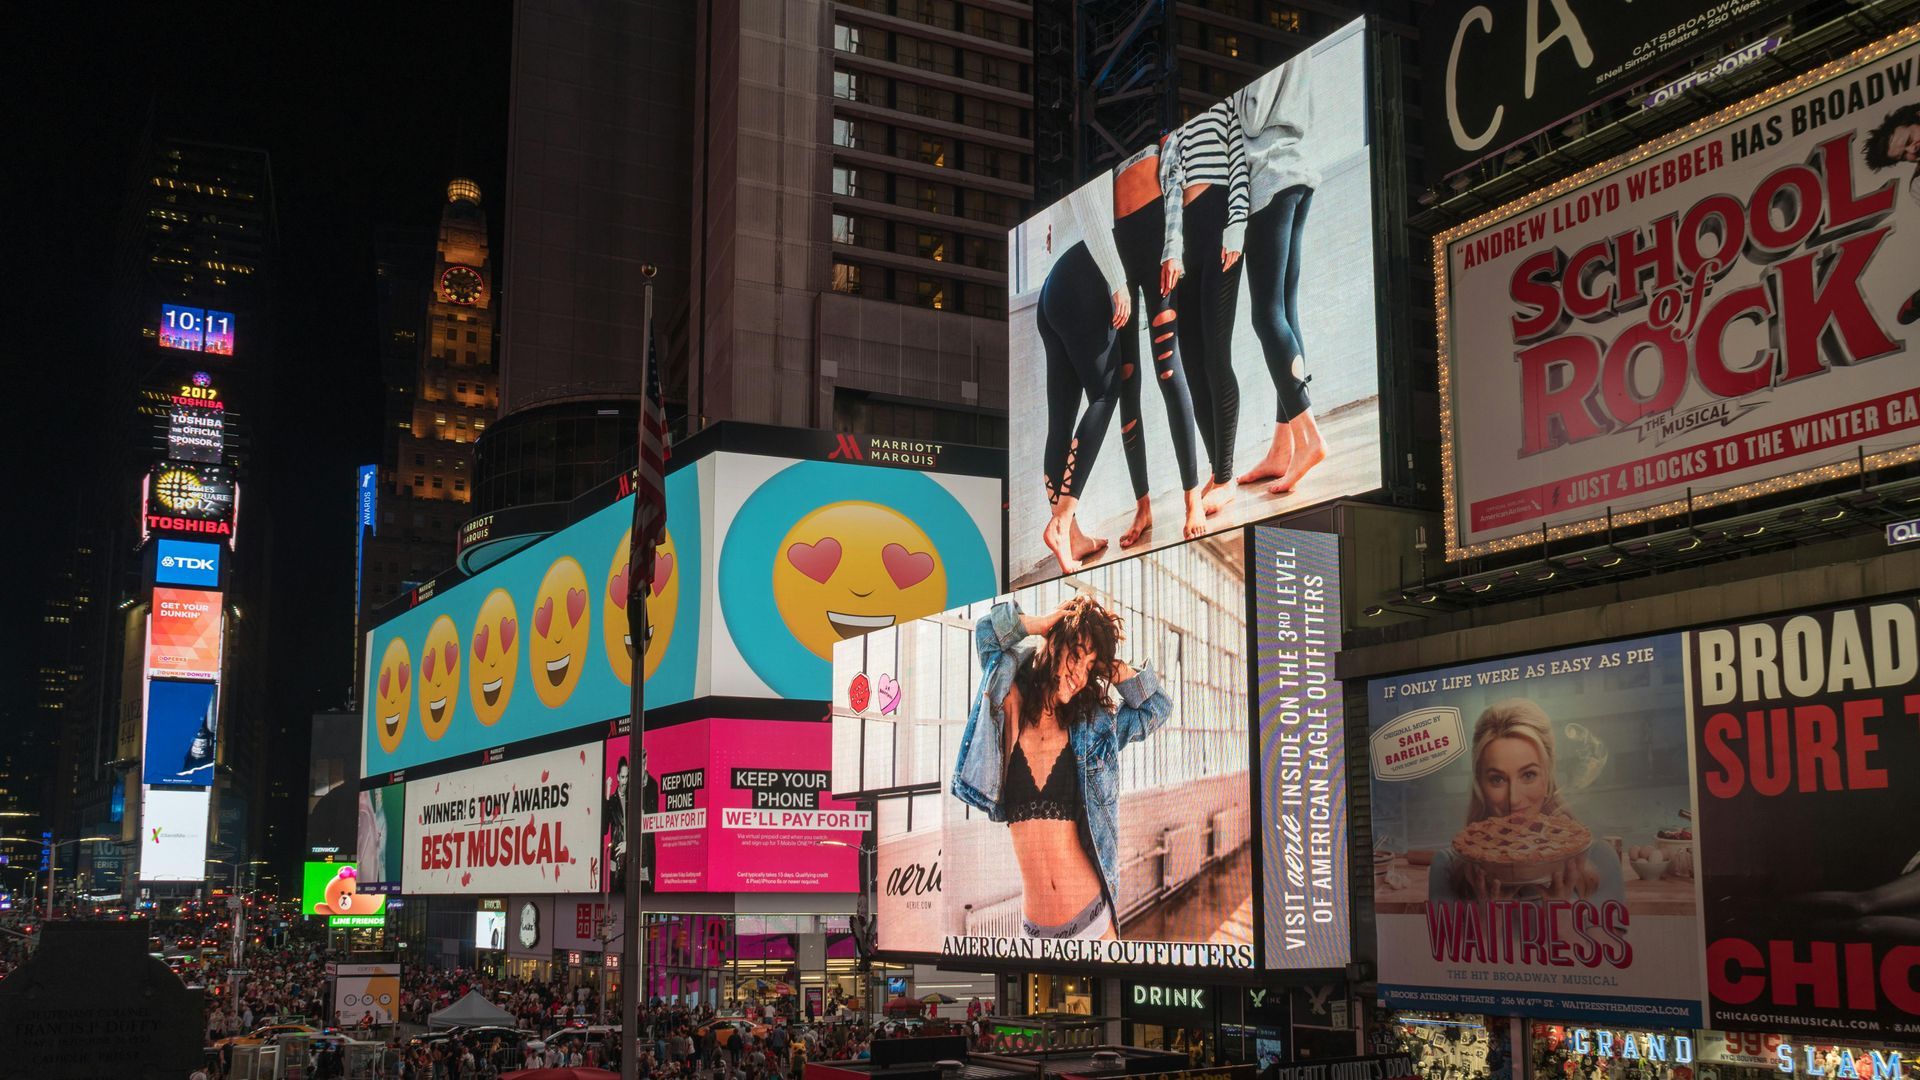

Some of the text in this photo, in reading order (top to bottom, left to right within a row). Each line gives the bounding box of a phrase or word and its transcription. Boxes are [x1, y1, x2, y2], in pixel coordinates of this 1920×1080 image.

[1603, 0, 1761, 80] Neil Simon Theatre 250 West
[1653, 40, 1769, 107] OUTFRONT
[1552, 182, 1620, 232] LLOYD
[1626, 140, 1724, 203] WEBBER
[1731, 115, 1783, 162] HAS
[1791, 54, 1920, 137] BROADW
[1509, 129, 1900, 344] SCHOOL
[1645, 257, 1722, 341] of
[166, 310, 229, 334] 10:11
[1514, 226, 1906, 459] ROCK
[171, 396, 224, 410] TOSHIBA
[181, 386, 218, 400] 2017
[172, 414, 224, 428] TOSHIBA
[1644, 403, 1731, 439] THE MUSICAL
[170, 436, 212, 446] SPONSOR
[183, 426, 222, 438] OFFICIAL
[871, 438, 942, 454] MARRIOTT
[1567, 405, 1880, 504] JUST 4 BLOCKS TO THE WINTER
[871, 452, 934, 465] MARQUIS
[174, 496, 214, 510] 2017
[148, 515, 230, 534] TOSHIBA
[174, 557, 214, 570] TDK
[418, 580, 436, 594] MARRIOTT
[418, 590, 433, 602] MARQUIS
[160, 602, 208, 612] GET YOUR
[1699, 600, 1920, 706] BROAD
[1384, 648, 1654, 699] IF ONLY LIFE WERE AS EASY AS PIE
[1384, 715, 1440, 740] ORIGINAL MUSIC BY
[1276, 548, 1306, 950] VISIT aerie INSIDE ON THE 3RD LEVEL
[1304, 574, 1333, 923] OF AMERICAN EAGLE OUTFITTERS
[1398, 730, 1430, 748] SARA
[1704, 698, 1888, 798] SURE
[1384, 736, 1450, 766] BAREILLES
[662, 772, 702, 791] KEEP YOUR
[737, 772, 826, 788] KEEP YOUR
[422, 798, 467, 826] WINNER!
[468, 798, 476, 819] 6
[478, 792, 511, 818] TONY
[667, 794, 693, 810] PHONE
[758, 792, 814, 808] PHONE
[666, 814, 679, 829] PAY
[681, 812, 696, 828] FOR
[697, 812, 706, 826] IT
[726, 812, 869, 828] WE’LL PAY FOR IT
[421, 821, 576, 870] BEST MUSICAL.
[906, 901, 932, 910] AERIE.COM
[1425, 900, 1633, 970] WAITRESS
[942, 936, 1251, 968] AMERICAN EAGLE OUTFITTERS
[1446, 970, 1618, 987] THE HIT BROADWAY MUSICAL
[1134, 985, 1205, 1010] DRINK
[1390, 990, 1419, 1000] BROOKS
[1420, 992, 1458, 1002] ATKINSON
[1460, 994, 1495, 1004] THEATRE
[1502, 996, 1516, 1006] 256
[1562, 1000, 1690, 1017] WAITRESSTHEMUSICAL.COM
[1716, 1011, 1880, 1030] CHICAGOTHEMUSICAL.COM
[1574, 1028, 1693, 1064] GRAND
[1736, 1056, 1767, 1064] SOUVENIR
[1776, 1044, 1903, 1080] SLAM
